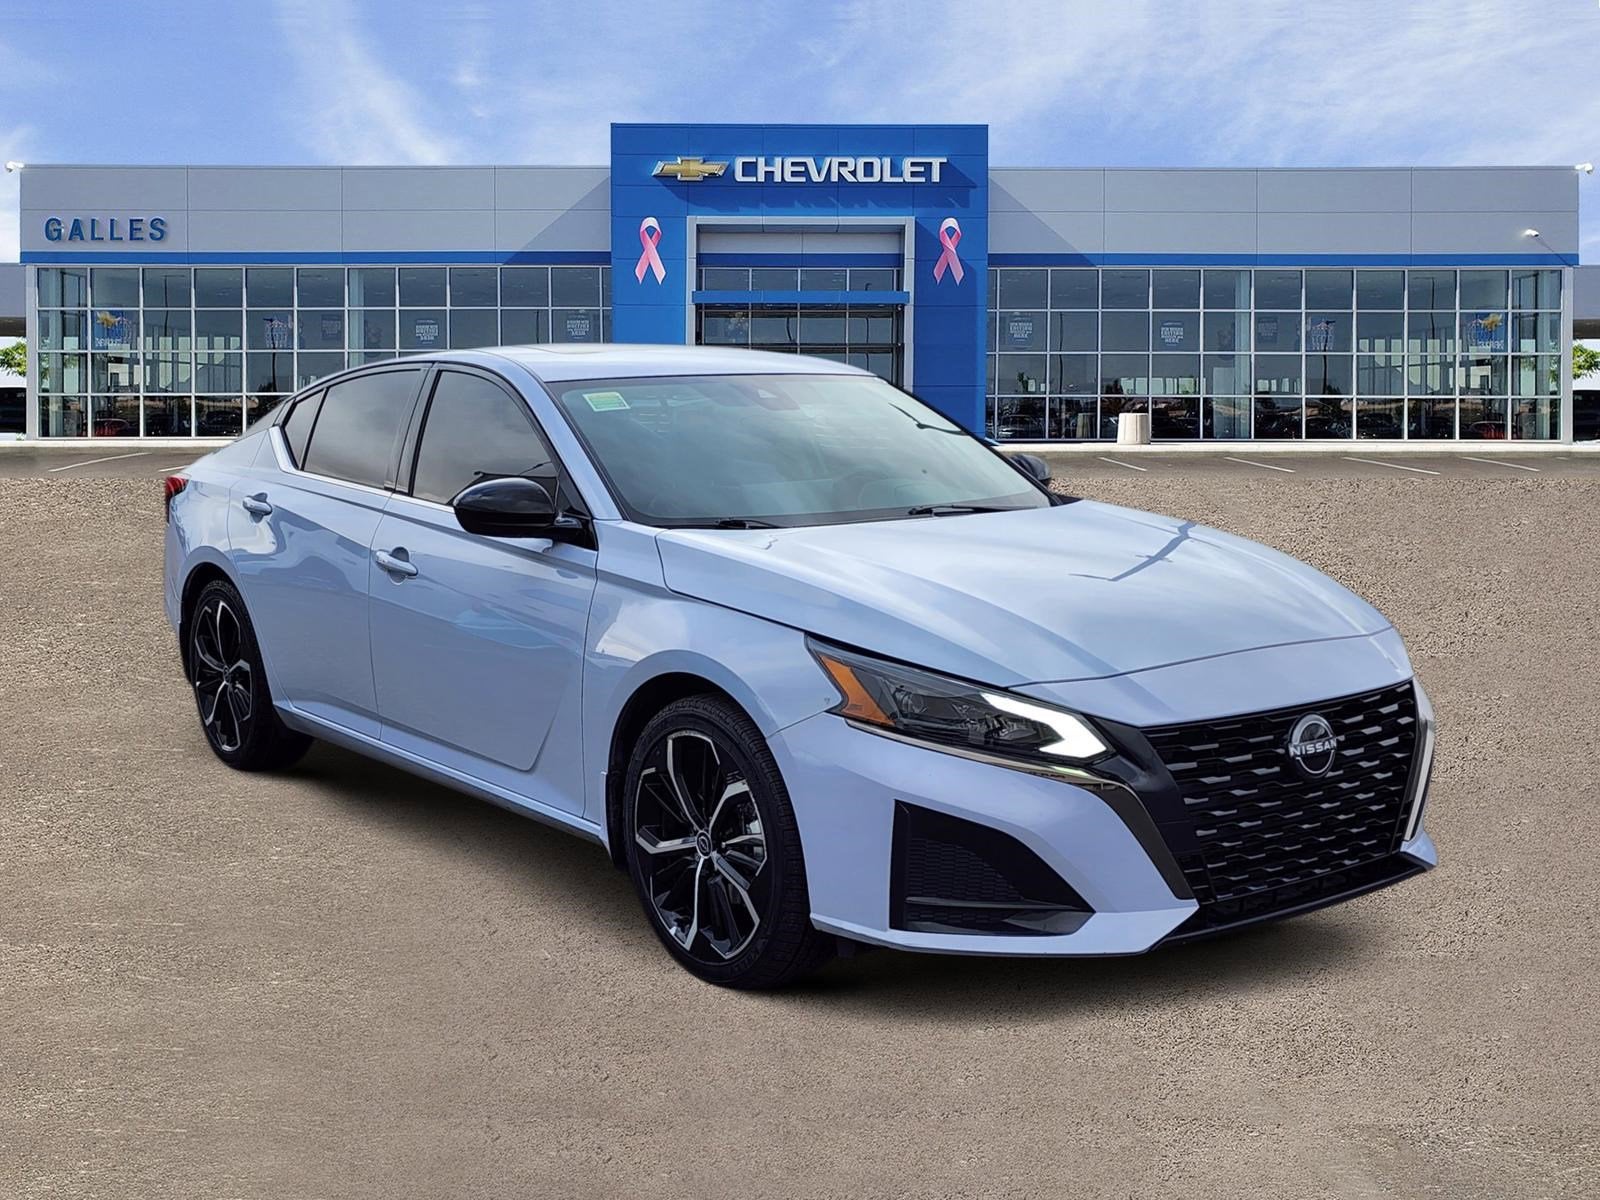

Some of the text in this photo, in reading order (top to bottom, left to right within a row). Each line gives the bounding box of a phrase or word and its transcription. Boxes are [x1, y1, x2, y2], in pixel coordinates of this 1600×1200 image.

[734, 156, 947, 183] CHEVROLET
[45, 217, 167, 241] GALLES
[1289, 739, 1337, 757] NISSAN
